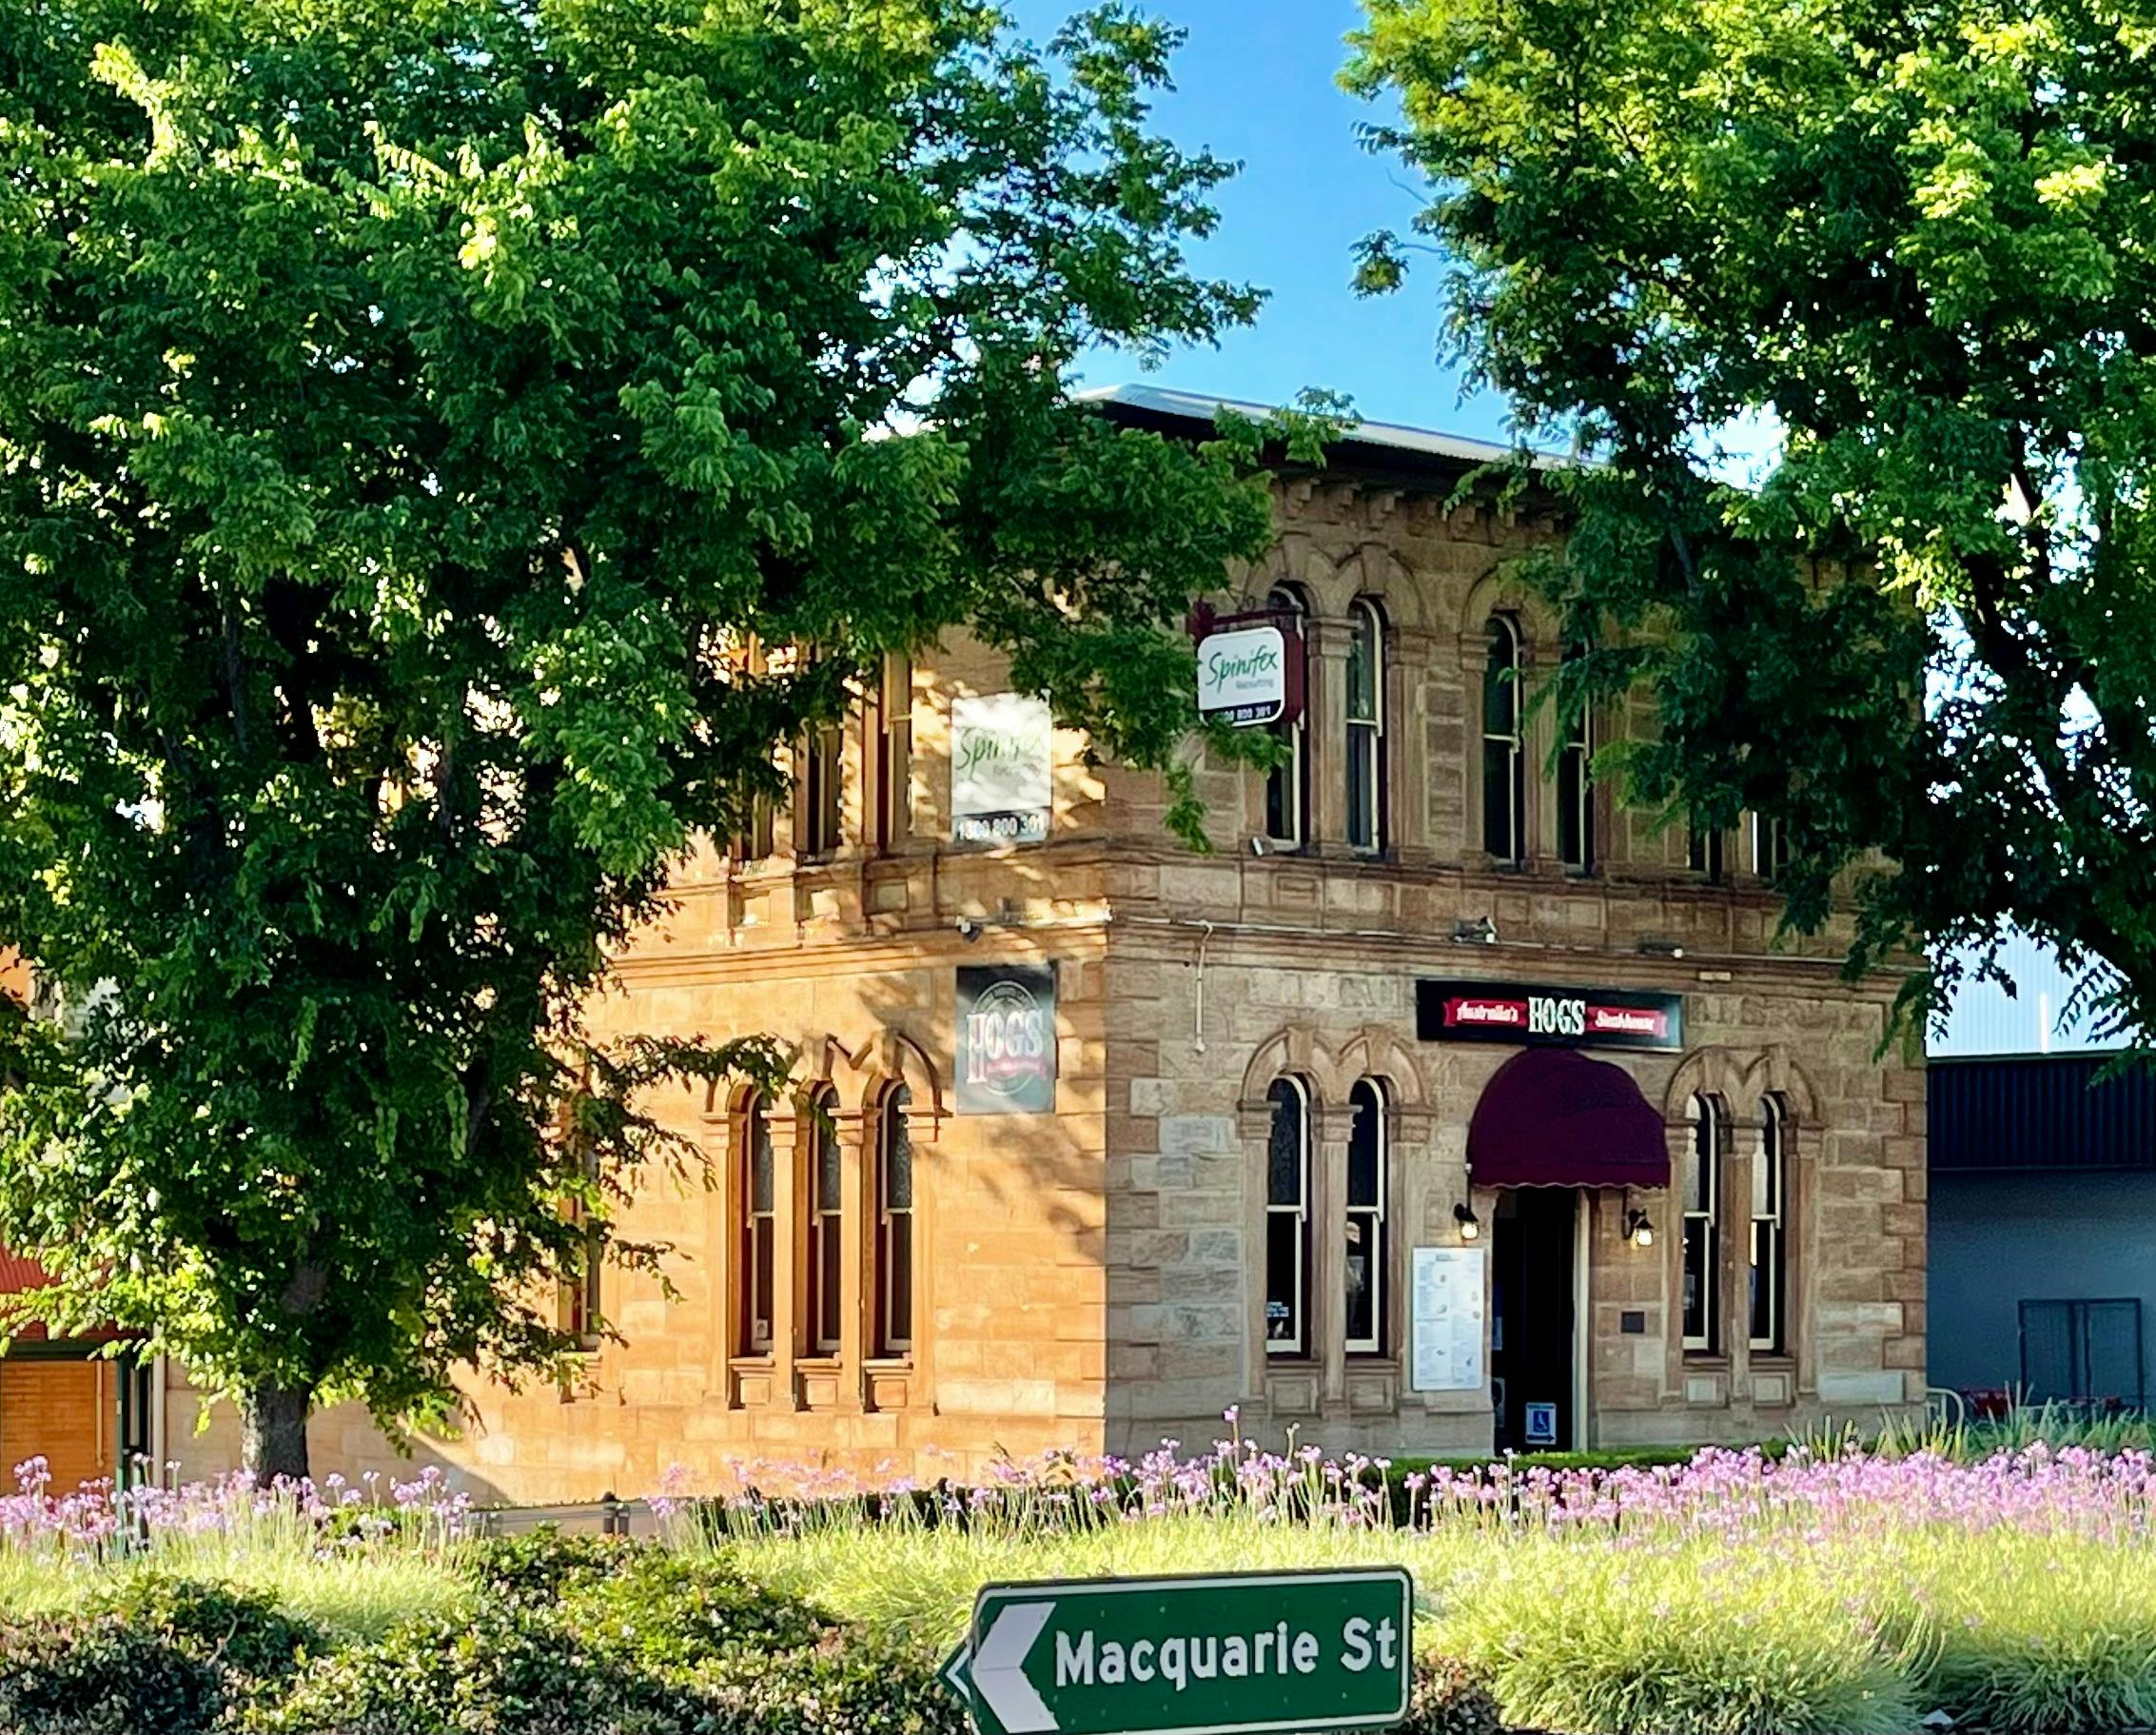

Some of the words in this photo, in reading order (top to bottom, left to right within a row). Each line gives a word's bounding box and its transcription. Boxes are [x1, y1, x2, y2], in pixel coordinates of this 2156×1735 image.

[1205, 644, 1278, 694] Spinifex
[967, 1009, 1044, 1084] HOGS
[1528, 996, 1586, 1035] HOGS
[1055, 1621, 1319, 1691] Macquarie
[1340, 1617, 1397, 1671] St
